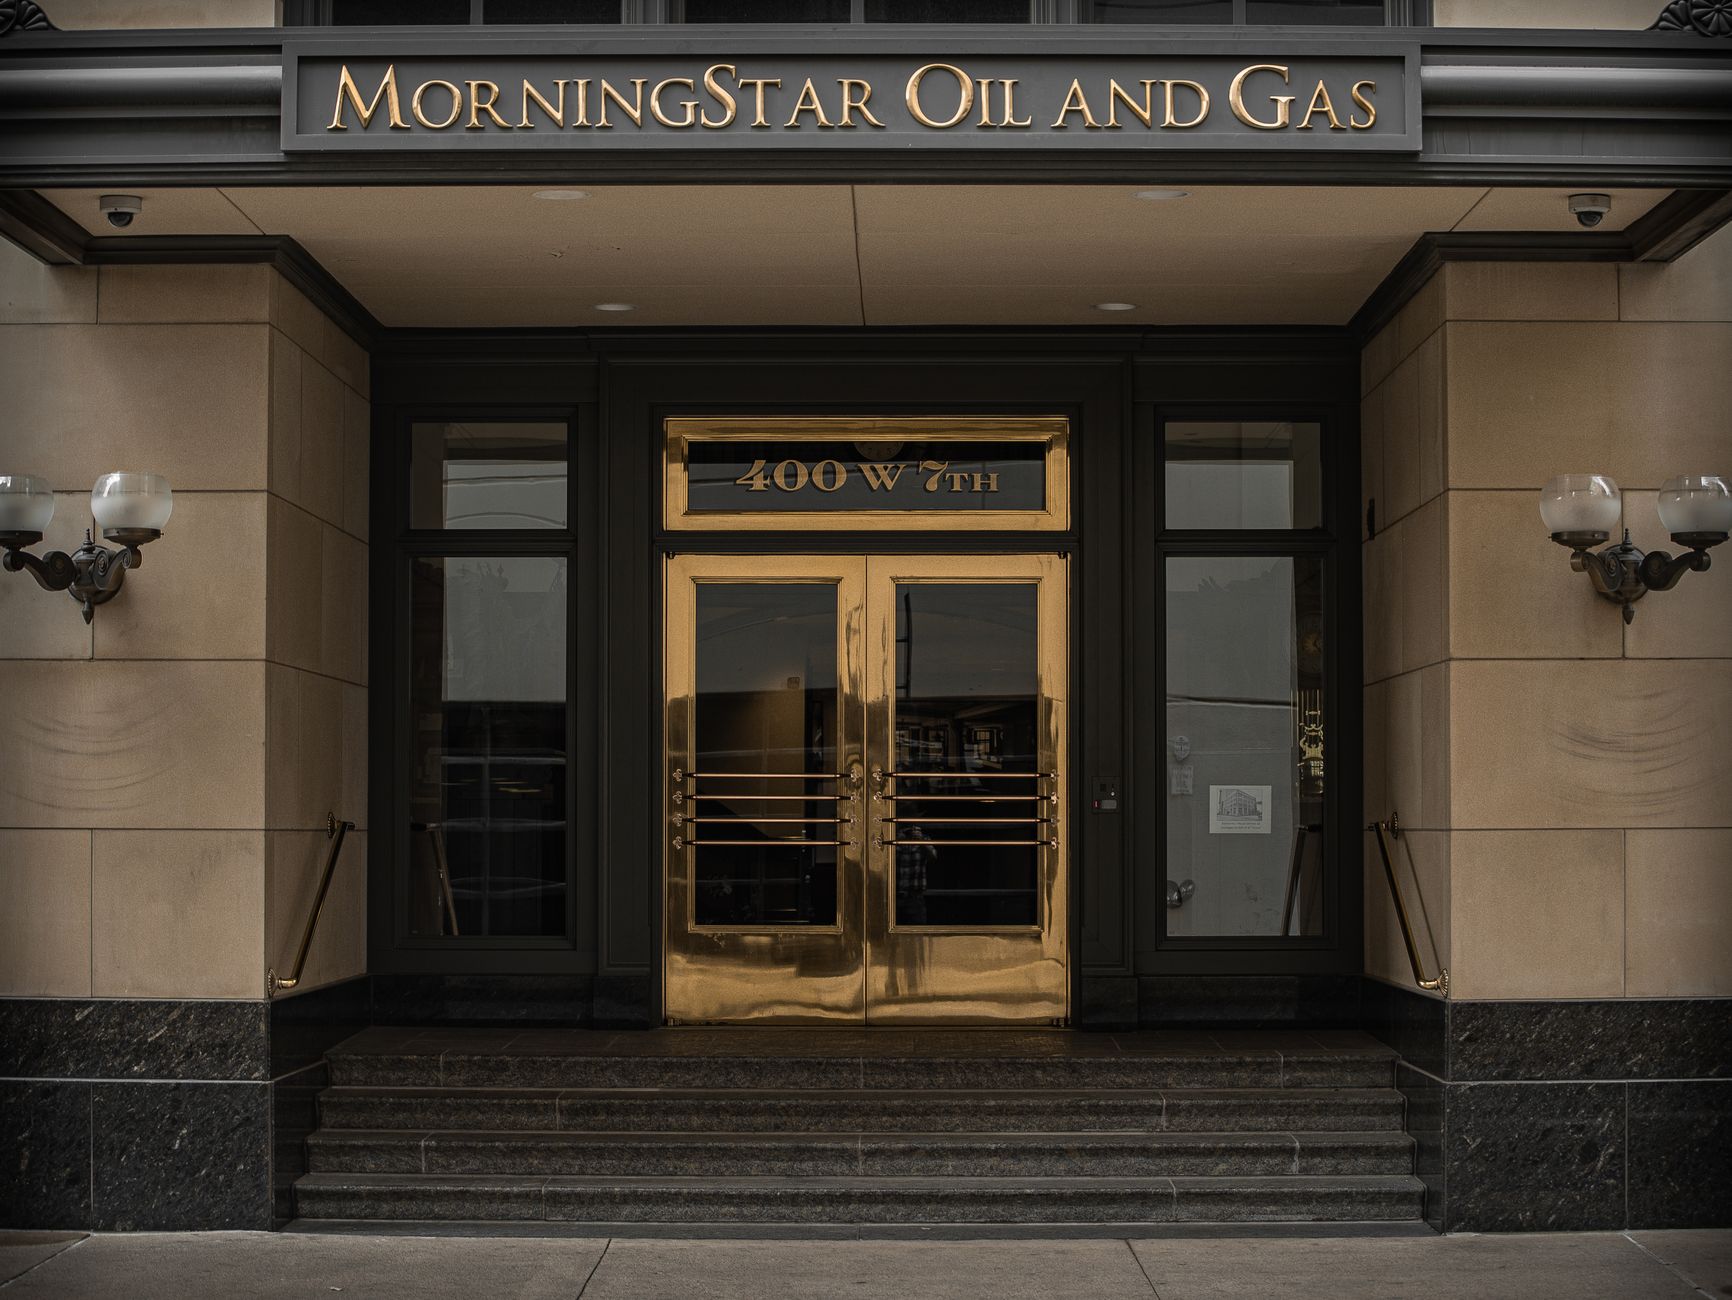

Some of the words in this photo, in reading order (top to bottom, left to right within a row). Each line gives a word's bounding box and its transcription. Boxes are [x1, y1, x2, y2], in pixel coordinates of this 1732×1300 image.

[1050, 78, 1212, 129] AND
[735, 459, 848, 492] 400
[857, 463, 906, 492] W
[919, 460, 1000, 492] 7TH
